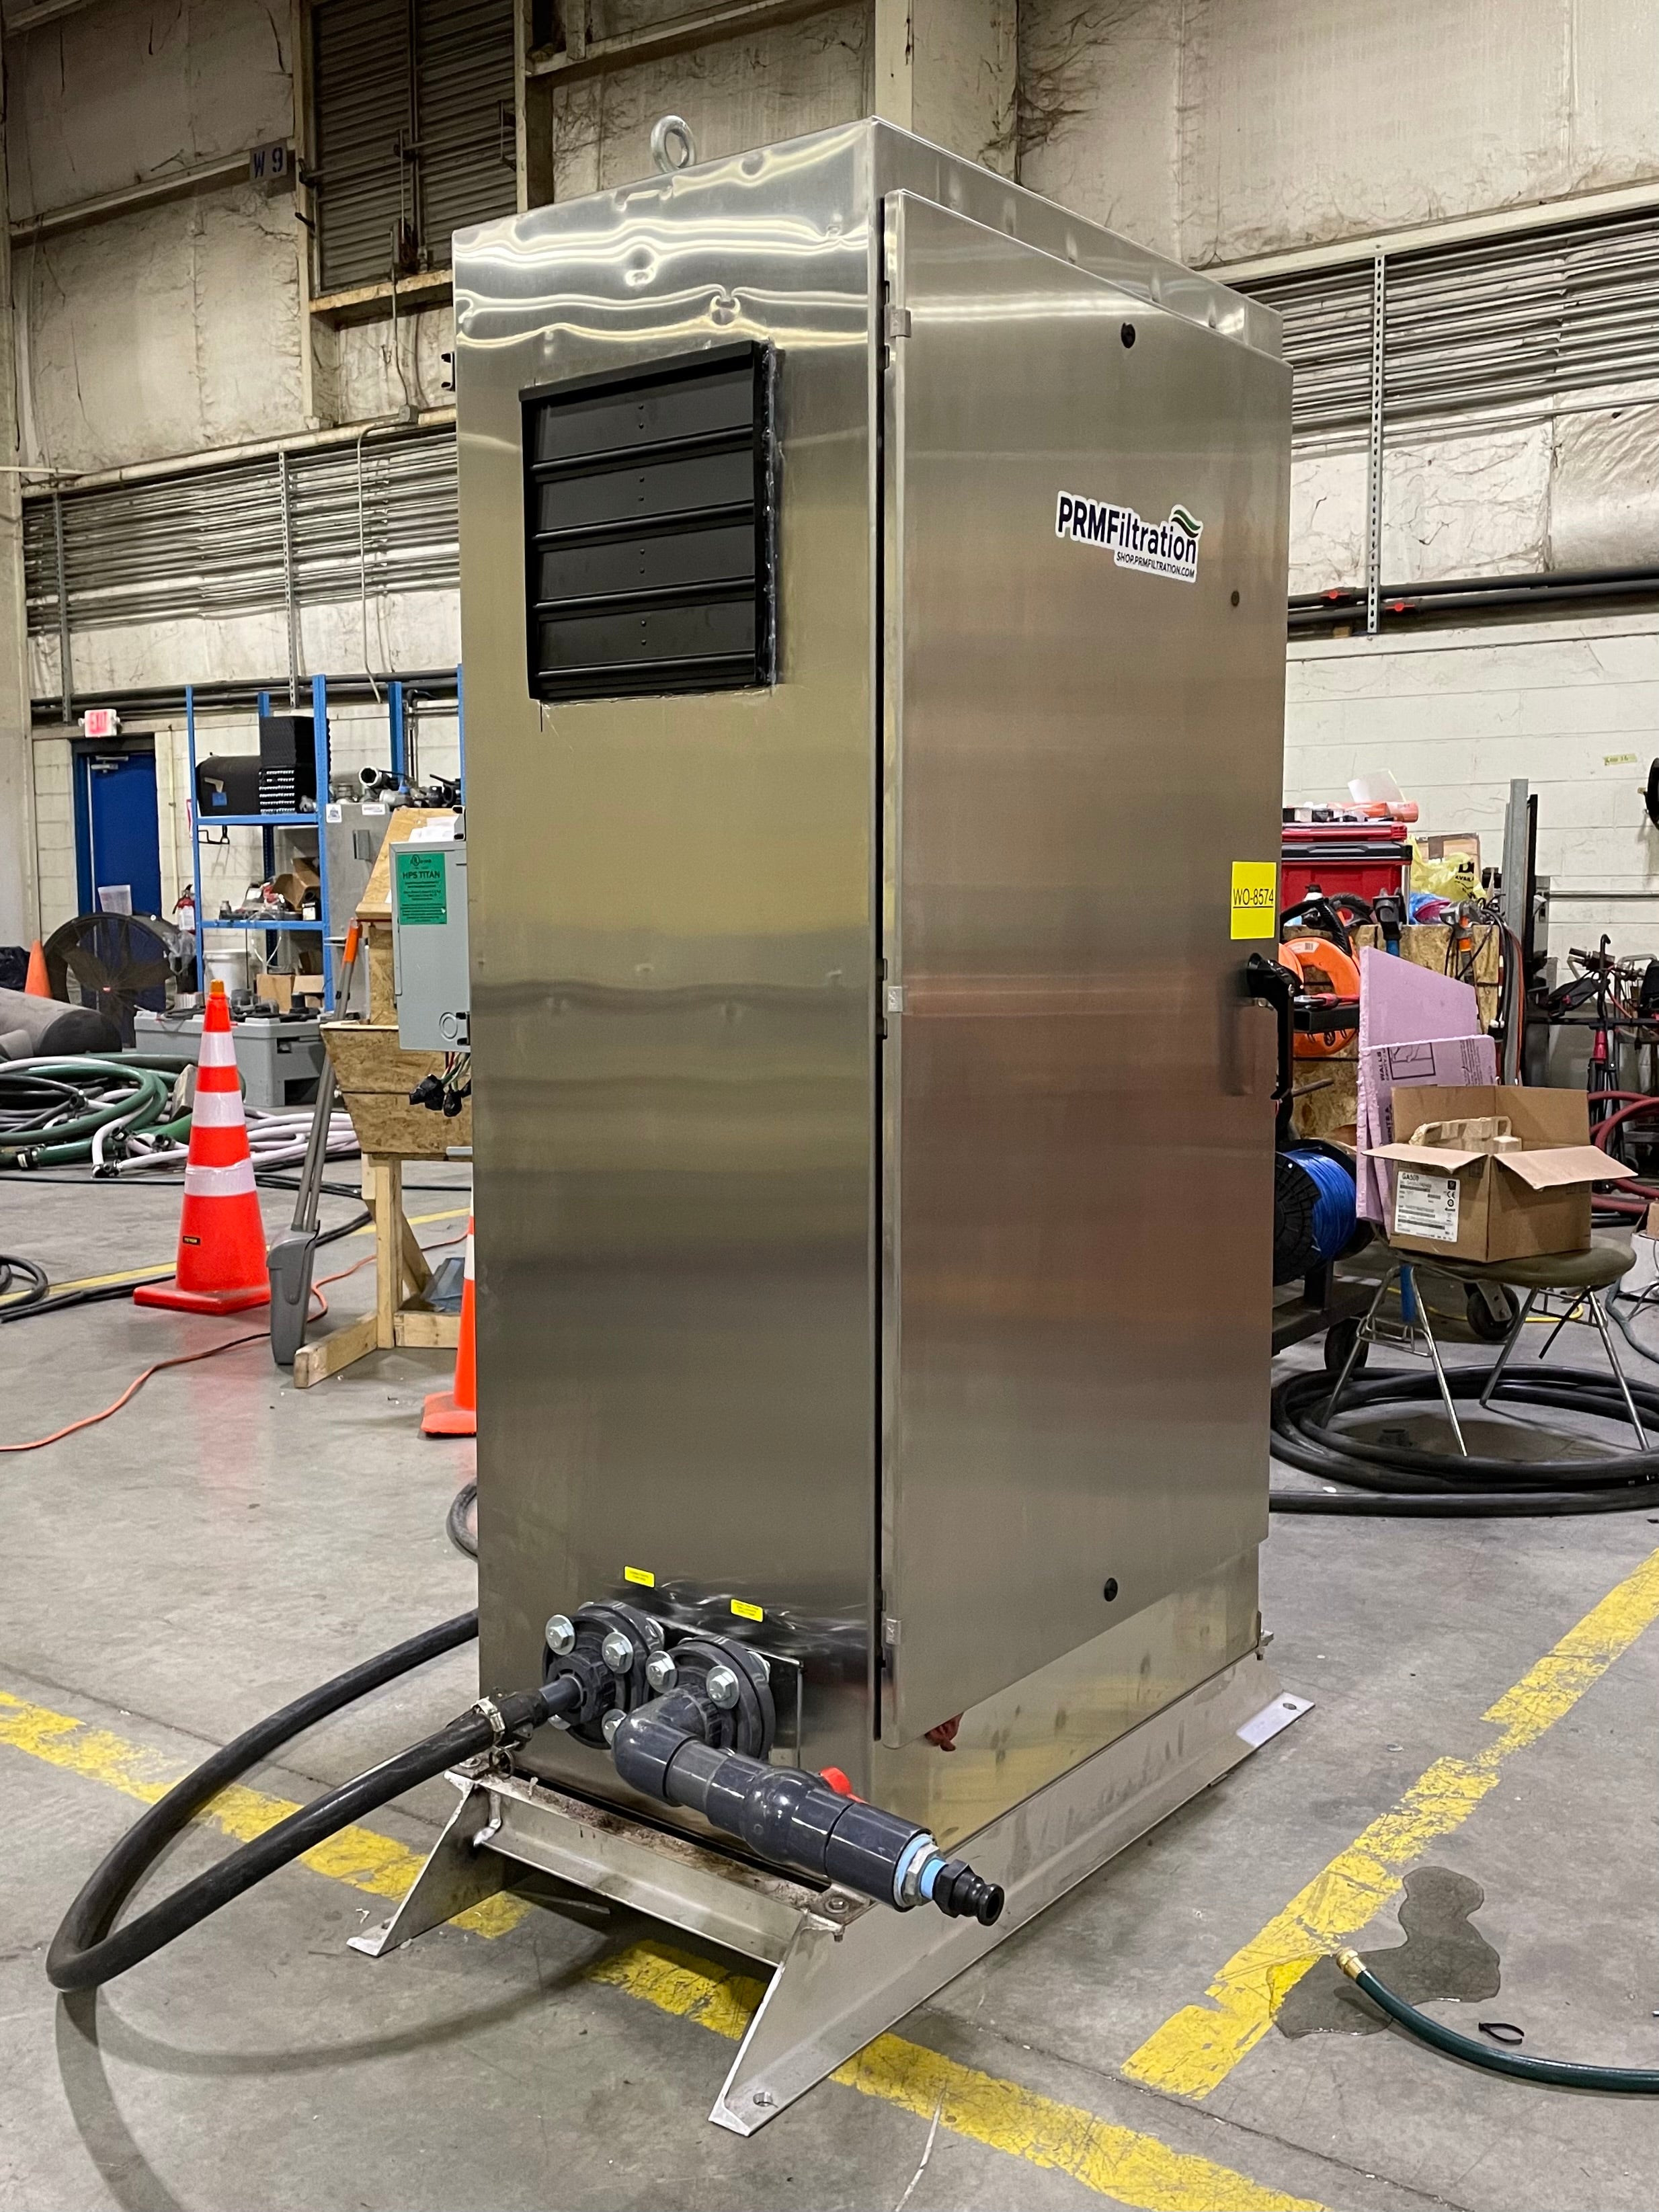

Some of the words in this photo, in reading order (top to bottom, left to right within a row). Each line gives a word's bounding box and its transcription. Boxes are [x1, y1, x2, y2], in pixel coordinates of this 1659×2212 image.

[254, 150, 265, 179] W
[272, 147, 283, 173] 9
[1058, 496, 1197, 564] PRMFiltration
[1116, 550, 1195, 579] SHOP.PRMFILTRATION.COM
[402, 871, 417, 880] HPS
[419, 870, 441, 879] TITAN
[1233, 888, 1274, 905] WO-8574
